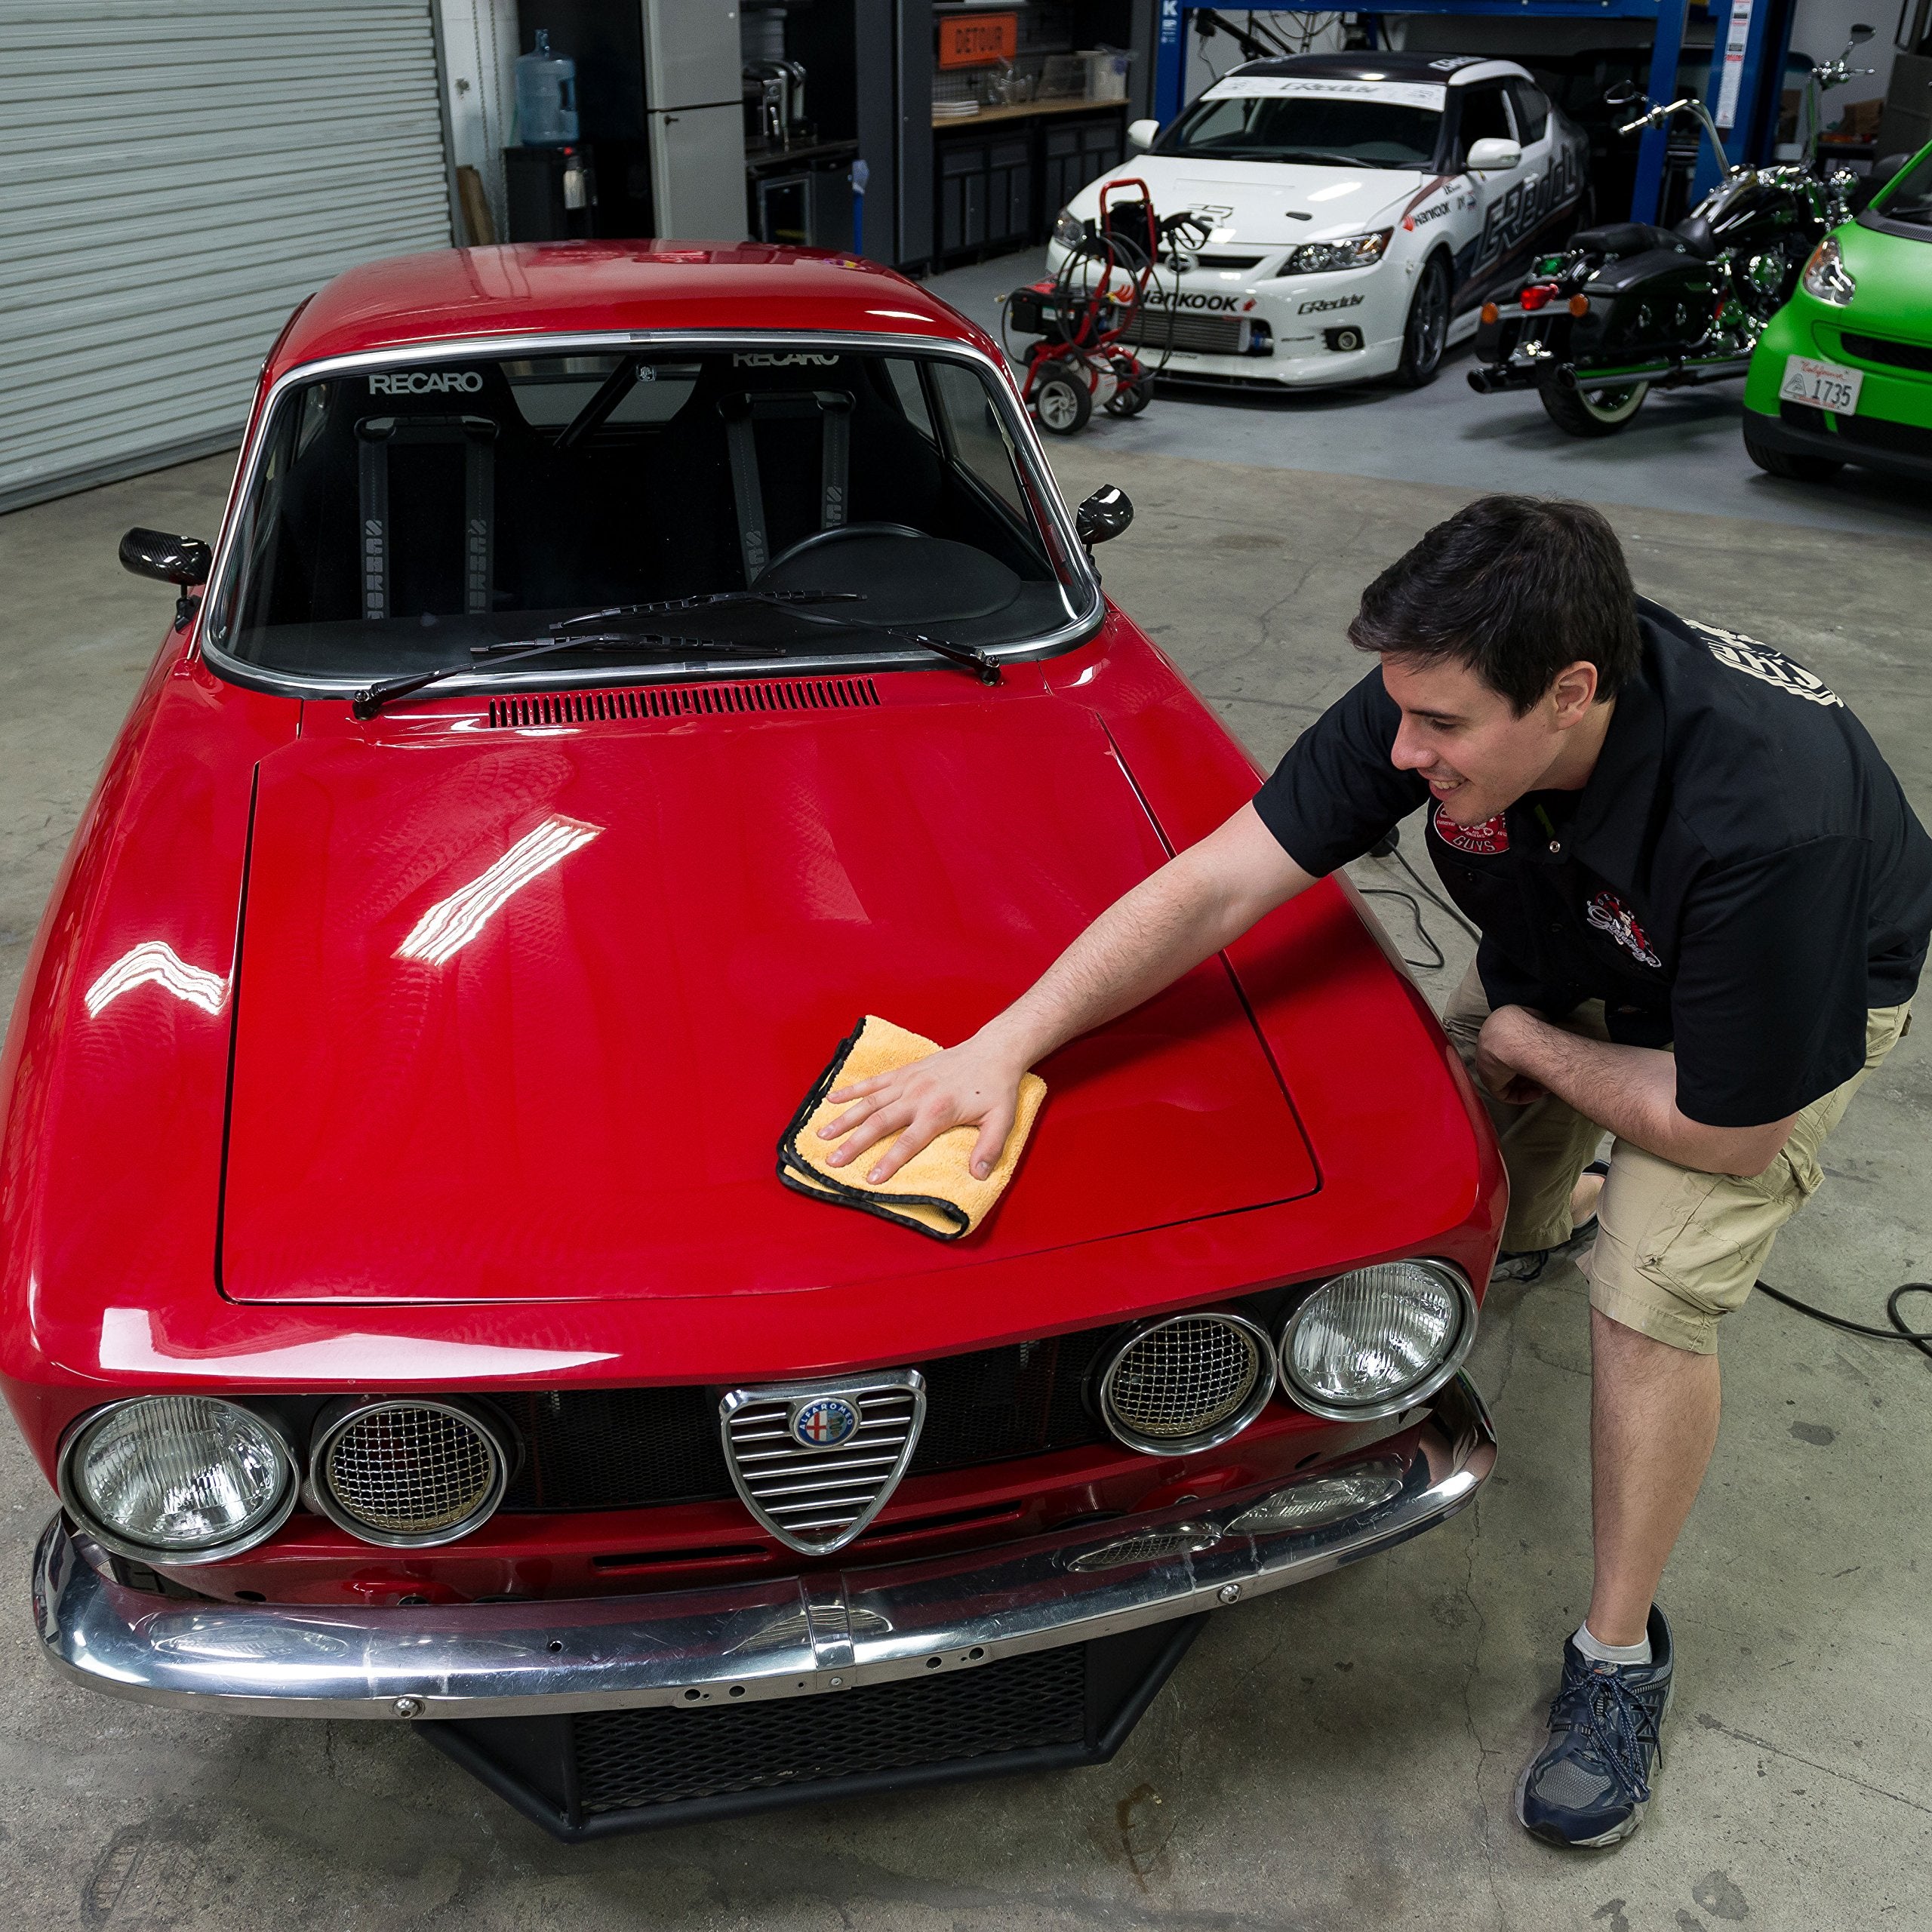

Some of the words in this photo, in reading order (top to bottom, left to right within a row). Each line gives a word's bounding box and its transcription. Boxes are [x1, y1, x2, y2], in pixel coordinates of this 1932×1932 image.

[369, 371, 483, 395] RECARO
[1812, 379, 1853, 407] 1735
[1452, 835, 1496, 851] GUYS
